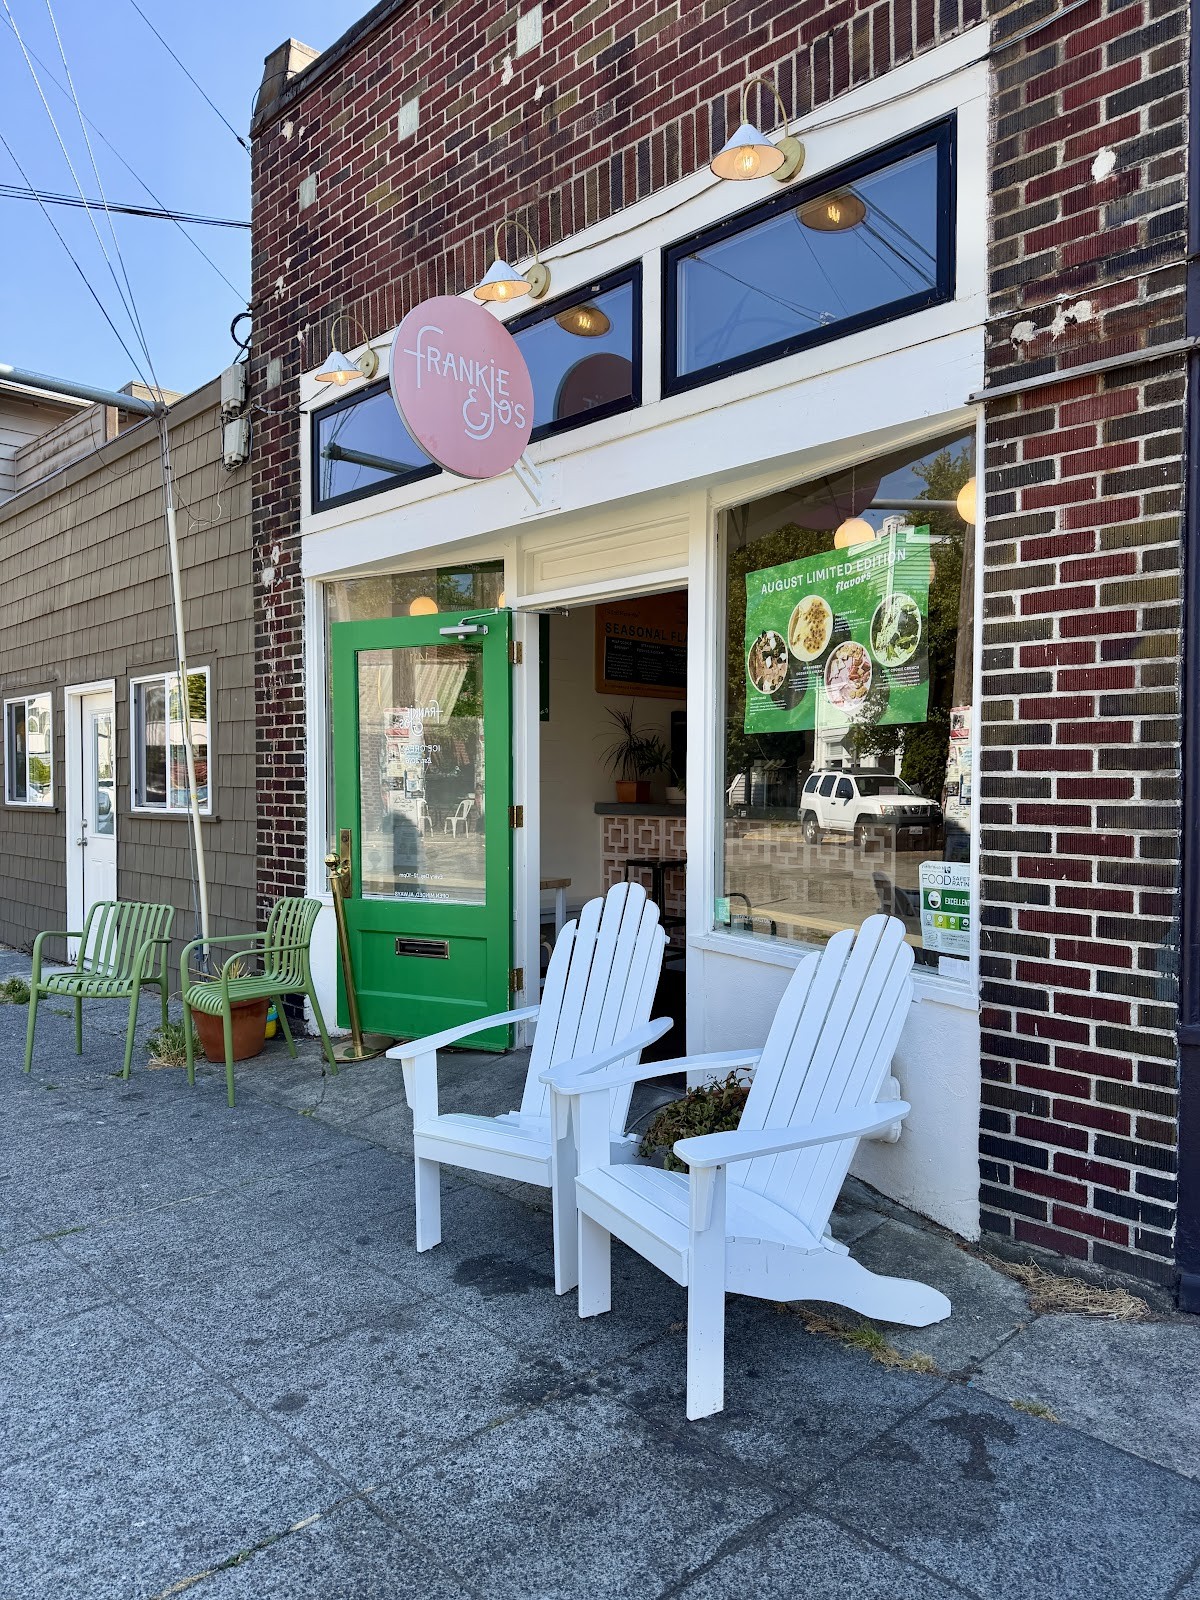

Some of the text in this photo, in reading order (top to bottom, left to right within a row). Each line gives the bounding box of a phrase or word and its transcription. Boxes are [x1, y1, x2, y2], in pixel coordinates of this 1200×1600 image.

[761, 548, 906, 595] AUGUST LIMITED EDITION
[835, 571, 872, 595] flavors
[605, 622, 666, 641] SEASONAL
[922, 873, 951, 886] FOOD
